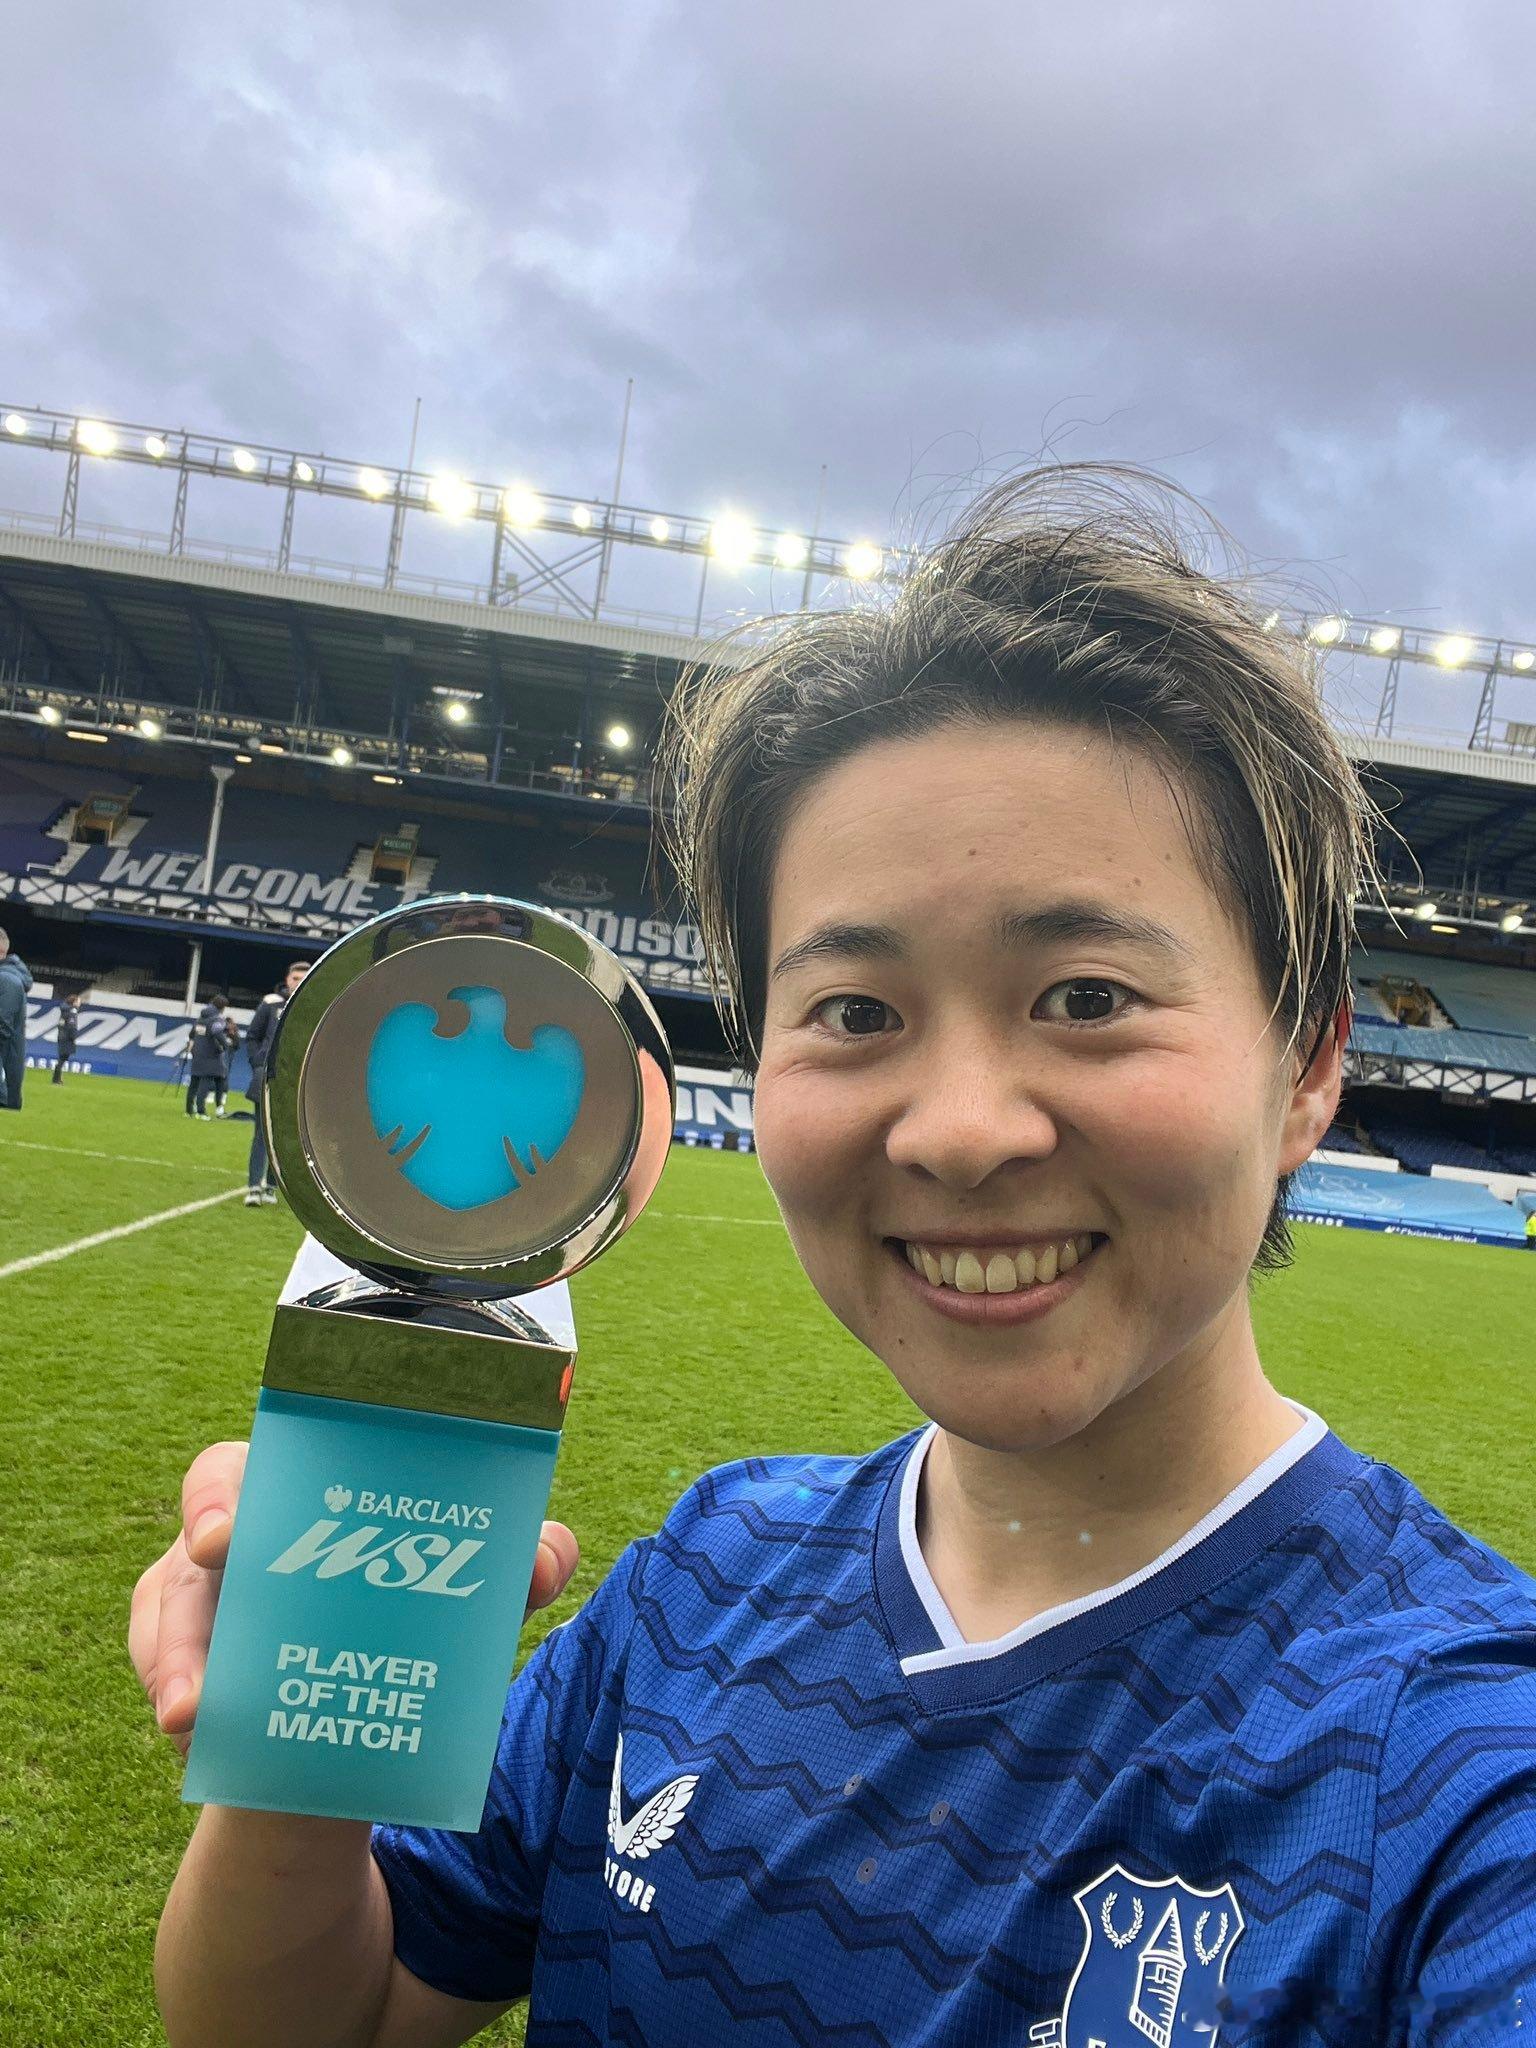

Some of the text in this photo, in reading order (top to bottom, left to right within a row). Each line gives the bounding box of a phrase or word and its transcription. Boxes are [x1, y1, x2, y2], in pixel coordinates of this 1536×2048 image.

[99, 849, 381, 916] WELCOME
[25, 1056, 92, 1074] ASTORE
[356, 1490, 493, 1530] BARCLAYS
[266, 1519, 486, 1597] WSL
[276, 1643, 439, 1688] PLAYER
[278, 1678, 426, 1720] OF THE
[266, 1711, 423, 1753] MATCH
